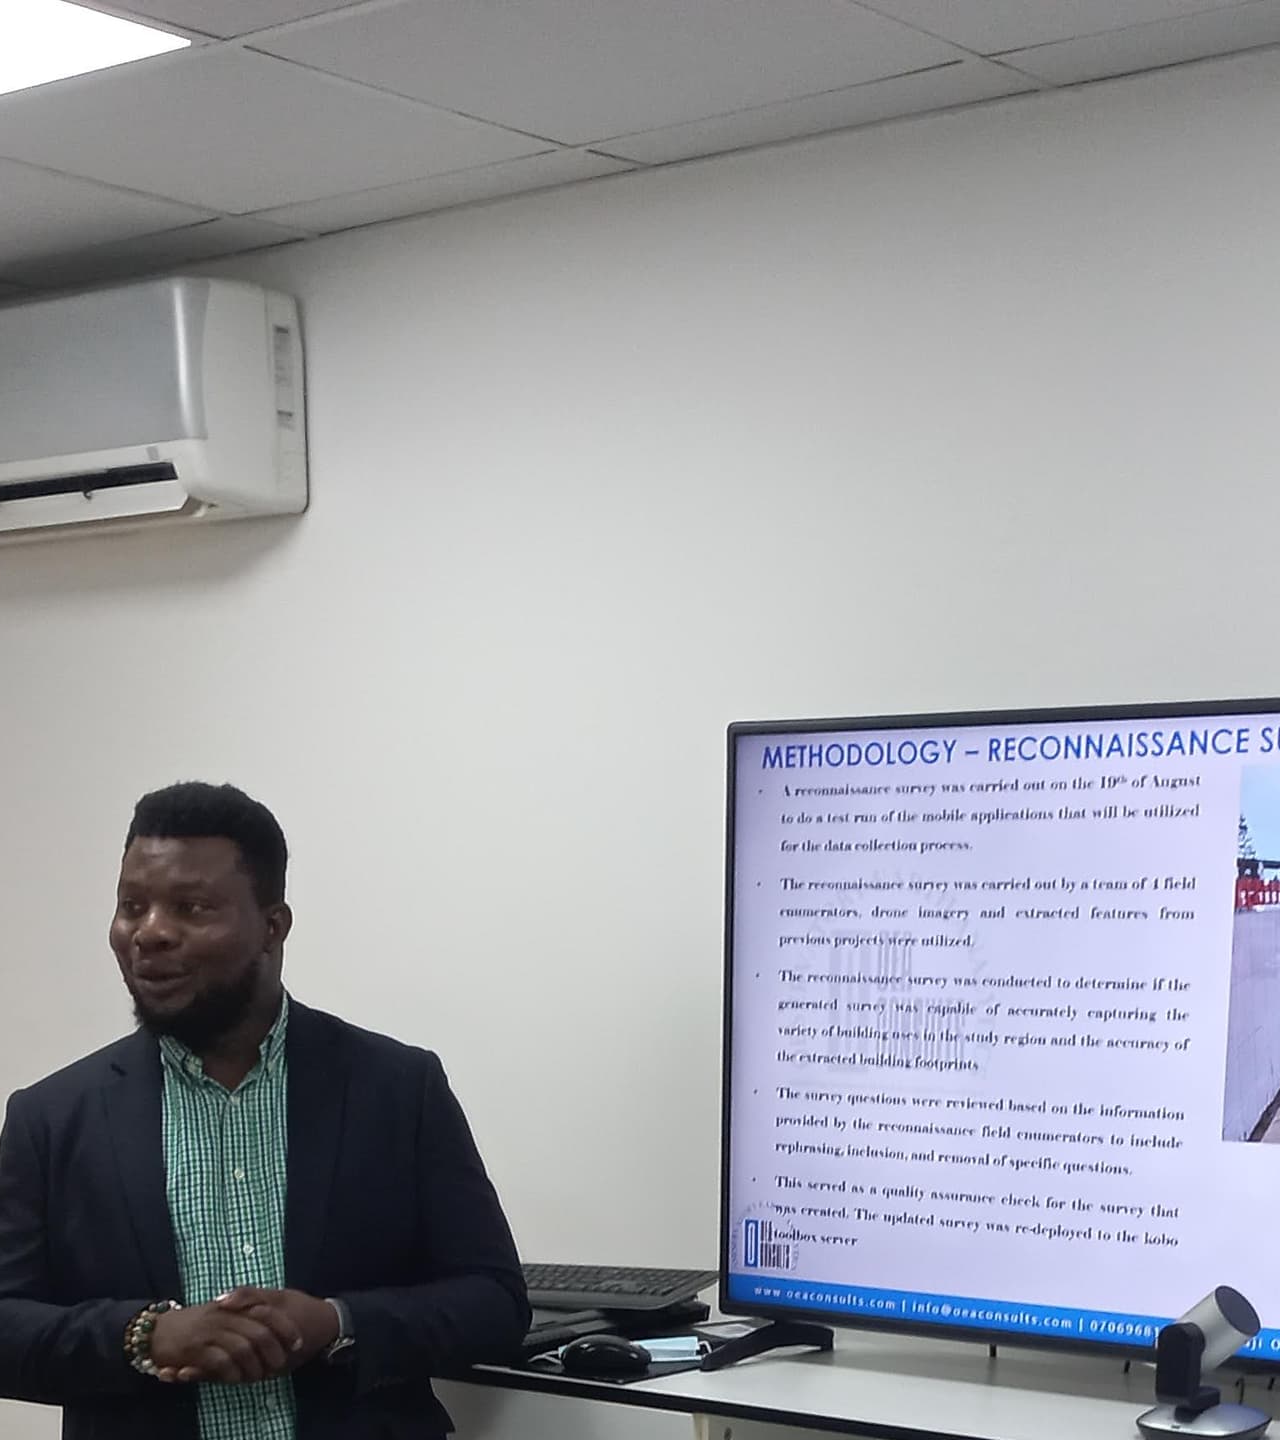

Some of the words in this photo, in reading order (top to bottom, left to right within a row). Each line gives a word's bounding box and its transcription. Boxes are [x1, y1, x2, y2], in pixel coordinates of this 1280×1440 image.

[762, 739, 957, 769] METHODOLOGY
[988, 728, 1250, 762] RECONNAISSANCE
[794, 783, 890, 797] reconnaissance
[895, 784, 935, 797] survey
[941, 783, 965, 793] was
[969, 777, 1019, 792] carried
[1022, 779, 1045, 791] out
[1050, 780, 1067, 791] on
[1072, 776, 1094, 790] the
[1131, 774, 1148, 788] of
[1153, 774, 1200, 789] August
[780, 813, 793, 824] to
[796, 811, 812, 824] do
[815, 814, 823, 823] a
[827, 812, 849, 824] test
[853, 814, 877, 823] run
[880, 809, 895, 823] of
[897, 809, 918, 822] the
[922, 807, 966, 823] mobile
[970, 807, 1053, 825] applications
[1058, 805, 1086, 820] that
[1092, 804, 1118, 819] will
[1122, 804, 1138, 818] be
[1143, 803, 1199, 818] utilized
[780, 839, 799, 852] for
[801, 839, 821, 852] the
[823, 839, 852, 852] data
[854, 838, 917, 852] collection
[779, 877, 804, 891] The
[808, 877, 904, 891] reconnaissance
[908, 881, 948, 894] survey
[953, 880, 977, 890] was
[981, 876, 1030, 891] carried
[1034, 878, 1056, 890] out
[1060, 876, 1076, 894] by
[1080, 881, 1088, 890] a
[1092, 878, 1128, 890] team
[1131, 876, 1148, 890] of
[1163, 876, 1196, 890] field
[871, 905, 908, 918] drone
[918, 905, 968, 922] imagery
[980, 905, 1005, 919] and
[1015, 905, 1079, 919] extracted
[1090, 905, 1148, 920] features
[1159, 906, 1194, 920] from
[778, 932, 830, 948] previous
[834, 932, 884, 949] projects
[888, 933, 918, 946] were
[777, 968, 803, 982] The
[806, 971, 905, 987] reconnaissance
[907, 975, 948, 989] survey
[953, 977, 978, 987] was
[981, 975, 1052, 988] conducted
[1056, 977, 1071, 989] to
[1074, 975, 1148, 991] determine
[1152, 977, 1166, 992] if
[1167, 977, 1190, 992] the
[776, 997, 838, 1011] generated
[846, 1002, 886, 1016] survey
[894, 1000, 920, 1014] was
[926, 999, 978, 1018] capable
[984, 1002, 1002, 1016] of
[1006, 1004, 1078, 1022] accurately
[1086, 1007, 1158, 1023] capturing
[1166, 1007, 1190, 1021] the
[778, 1023, 818, 1040] variety
[820, 1024, 836, 1038] of
[836, 1024, 888, 1041] building
[940, 1025, 958, 1043] the
[964, 1029, 1000, 1047] study
[1004, 1031, 1046, 1047] region
[1050, 1033, 1076, 1047] and
[1080, 1034, 1102, 1048] the
[1106, 1038, 1170, 1053] accuracy
[1174, 1037, 1190, 1051] of
[777, 1049, 796, 1063] the
[799, 1052, 856, 1065] extracted
[859, 1050, 912, 1069] building
[914, 1052, 978, 1072] footprints
[775, 1086, 800, 1100] The
[804, 1091, 842, 1105] survey
[847, 1092, 906, 1106] questions
[912, 1097, 942, 1107] were
[946, 1096, 1004, 1111] reviewed
[1008, 1098, 1046, 1114] based
[1050, 1105, 1068, 1115] on
[1072, 1101, 1094, 1116] the
[1099, 1103, 1184, 1121] information
[775, 1114, 828, 1128] provided
[833, 1116, 846, 1132] by
[852, 1117, 873, 1131] the
[877, 1122, 976, 1136] reconnaissance
[981, 1124, 1011, 1139] field
[1016, 1130, 1104, 1144] enumerators
[1110, 1133, 1124, 1146] to
[1130, 1133, 1183, 1149] include
[910, 1149, 934, 1162] and
[938, 1152, 990, 1166] removal
[992, 1154, 1008, 1167] of
[1008, 1156, 1060, 1171] specific
[773, 1174, 802, 1189] This
[807, 1180, 846, 1193] served
[850, 1184, 864, 1194] as
[869, 1186, 877, 1195] a
[881, 1184, 926, 1202] quality
[930, 1191, 996, 1204] assurance
[1000, 1192, 1040, 1208] check
[1045, 1195, 1066, 1210] for
[1071, 1197, 1094, 1212] the
[1099, 1203, 1144, 1219] survey
[1150, 1203, 1179, 1219] that
[773, 1227, 816, 1243] toolbox
[820, 1235, 858, 1246] server
[853, 1207, 878, 1221] The
[883, 1211, 934, 1226] updated
[939, 1218, 979, 1233] survey
[986, 1222, 1010, 1232] was
[1097, 1229, 1111, 1241] to
[1116, 1229, 1138, 1243] the
